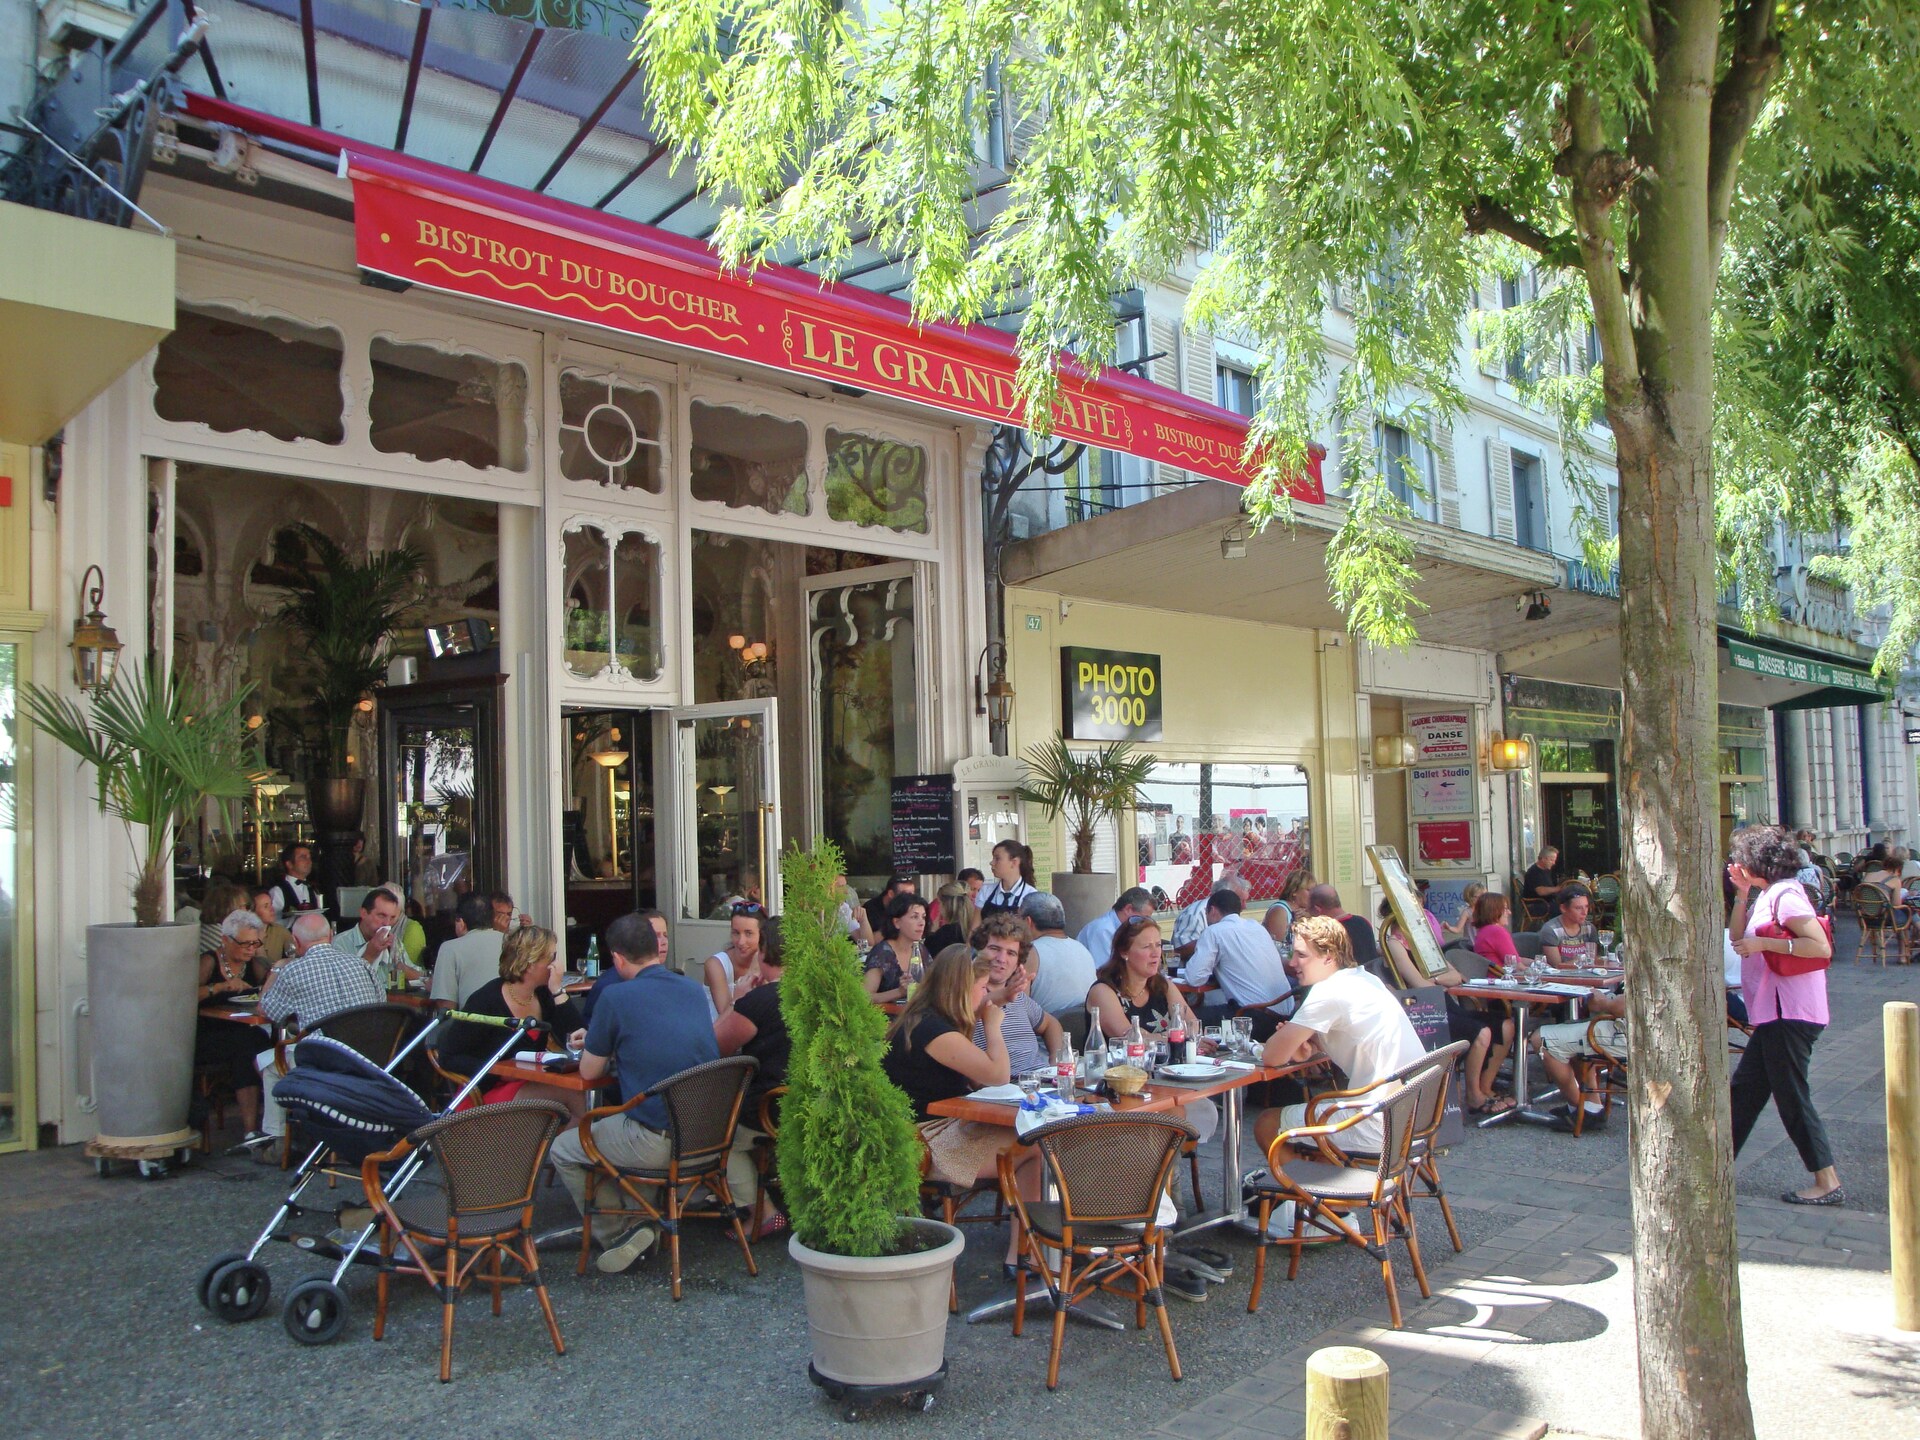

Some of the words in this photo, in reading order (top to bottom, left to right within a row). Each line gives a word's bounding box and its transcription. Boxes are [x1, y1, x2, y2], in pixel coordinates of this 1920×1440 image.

[416, 219, 553, 277] BISTROT
[561, 259, 601, 289] DU
[608, 271, 742, 326] BOUCHER
[801, 320, 860, 372] LE
[873, 343, 1019, 411] GRAND
[1032, 386, 1120, 439] AFÉ
[1155, 423, 1215, 455] BISTROT
[1218, 442, 1238, 461] DU
[1029, 617, 1041, 630] 47
[1078, 662, 1155, 696] PHOTO
[1758, 653, 1786, 676] BRASSERIE
[1091, 696, 1146, 726] 3000
[1428, 730, 1463, 740] DANSE
[1413, 770, 1439, 779] Ballet
[1442, 768, 1470, 778] Studio
